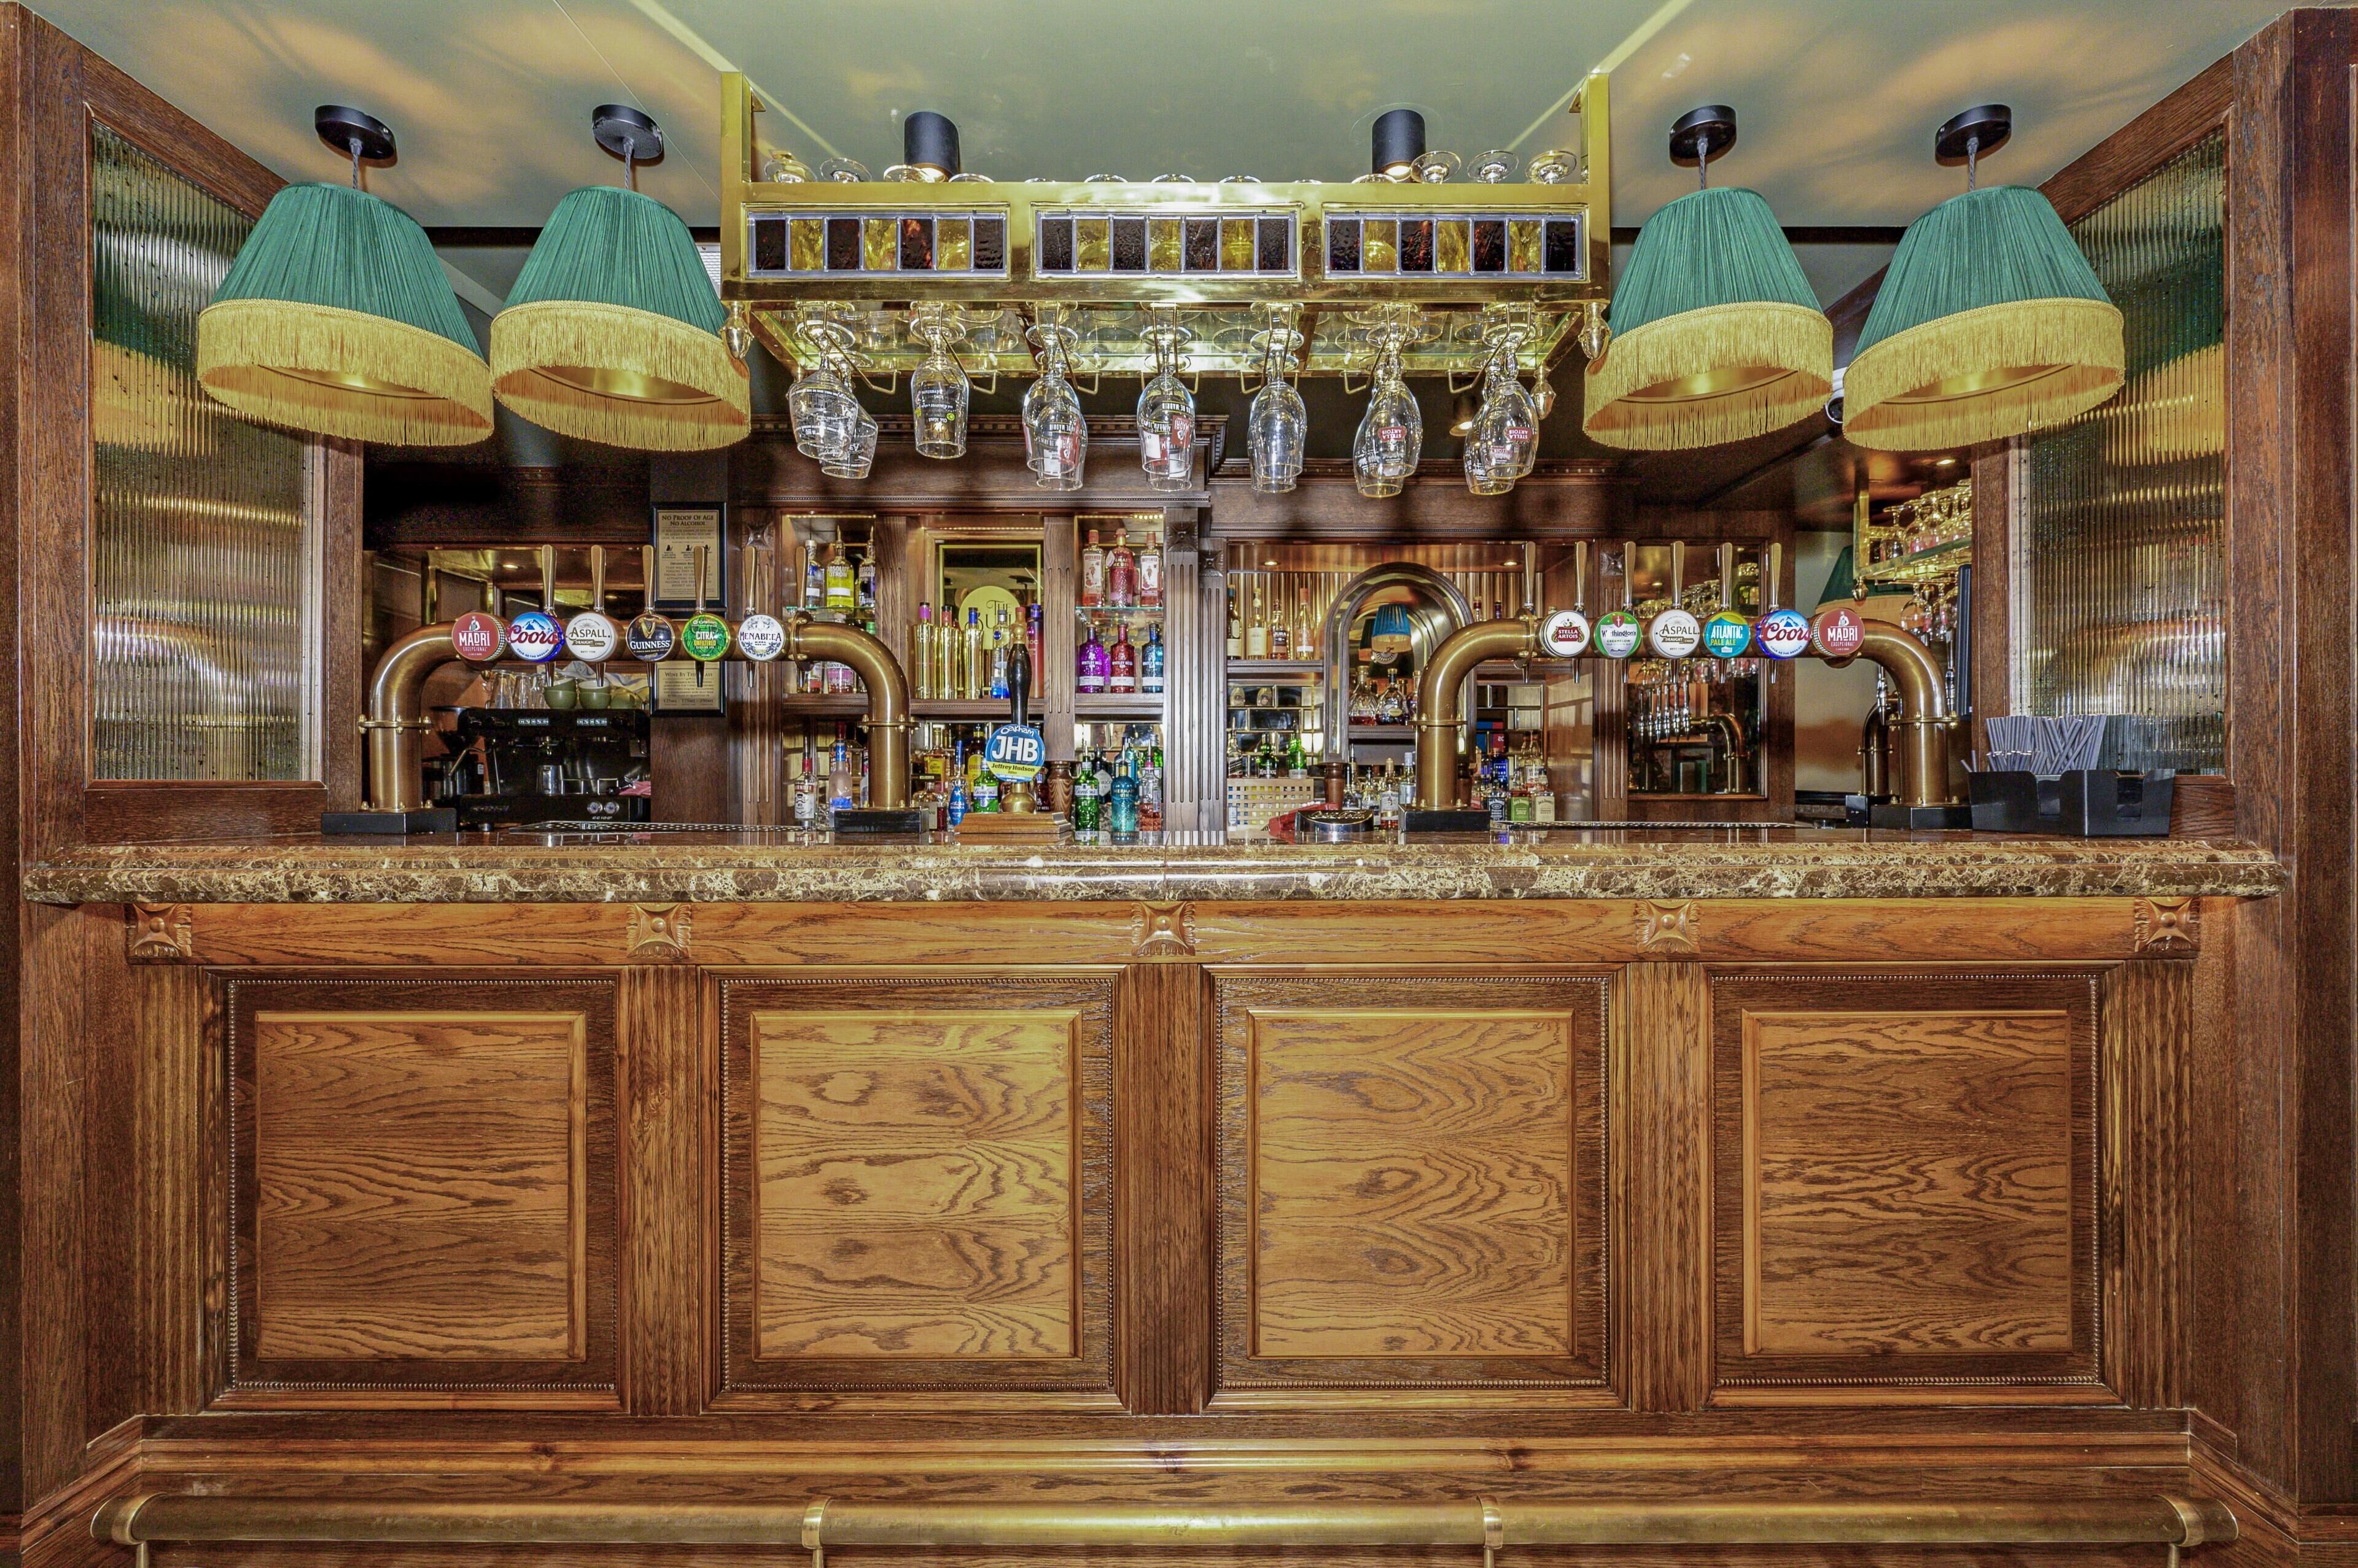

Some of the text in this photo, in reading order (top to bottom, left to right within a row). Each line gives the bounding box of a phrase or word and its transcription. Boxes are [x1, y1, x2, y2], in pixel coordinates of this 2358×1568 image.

[505, 624, 559, 645] Coors
[568, 627, 607, 641] ASPALL
[696, 631, 714, 640] CITRA
[1659, 624, 1697, 637] ASPALL
[1711, 625, 1743, 639] ATLANTIC
[1760, 622, 1812, 642] Coors
[629, 640, 671, 650] GUINNESS
[1000, 724, 1035, 736] Oakham
[992, 735, 1039, 762] JHB
[1012, 764, 1035, 772] Hudson
